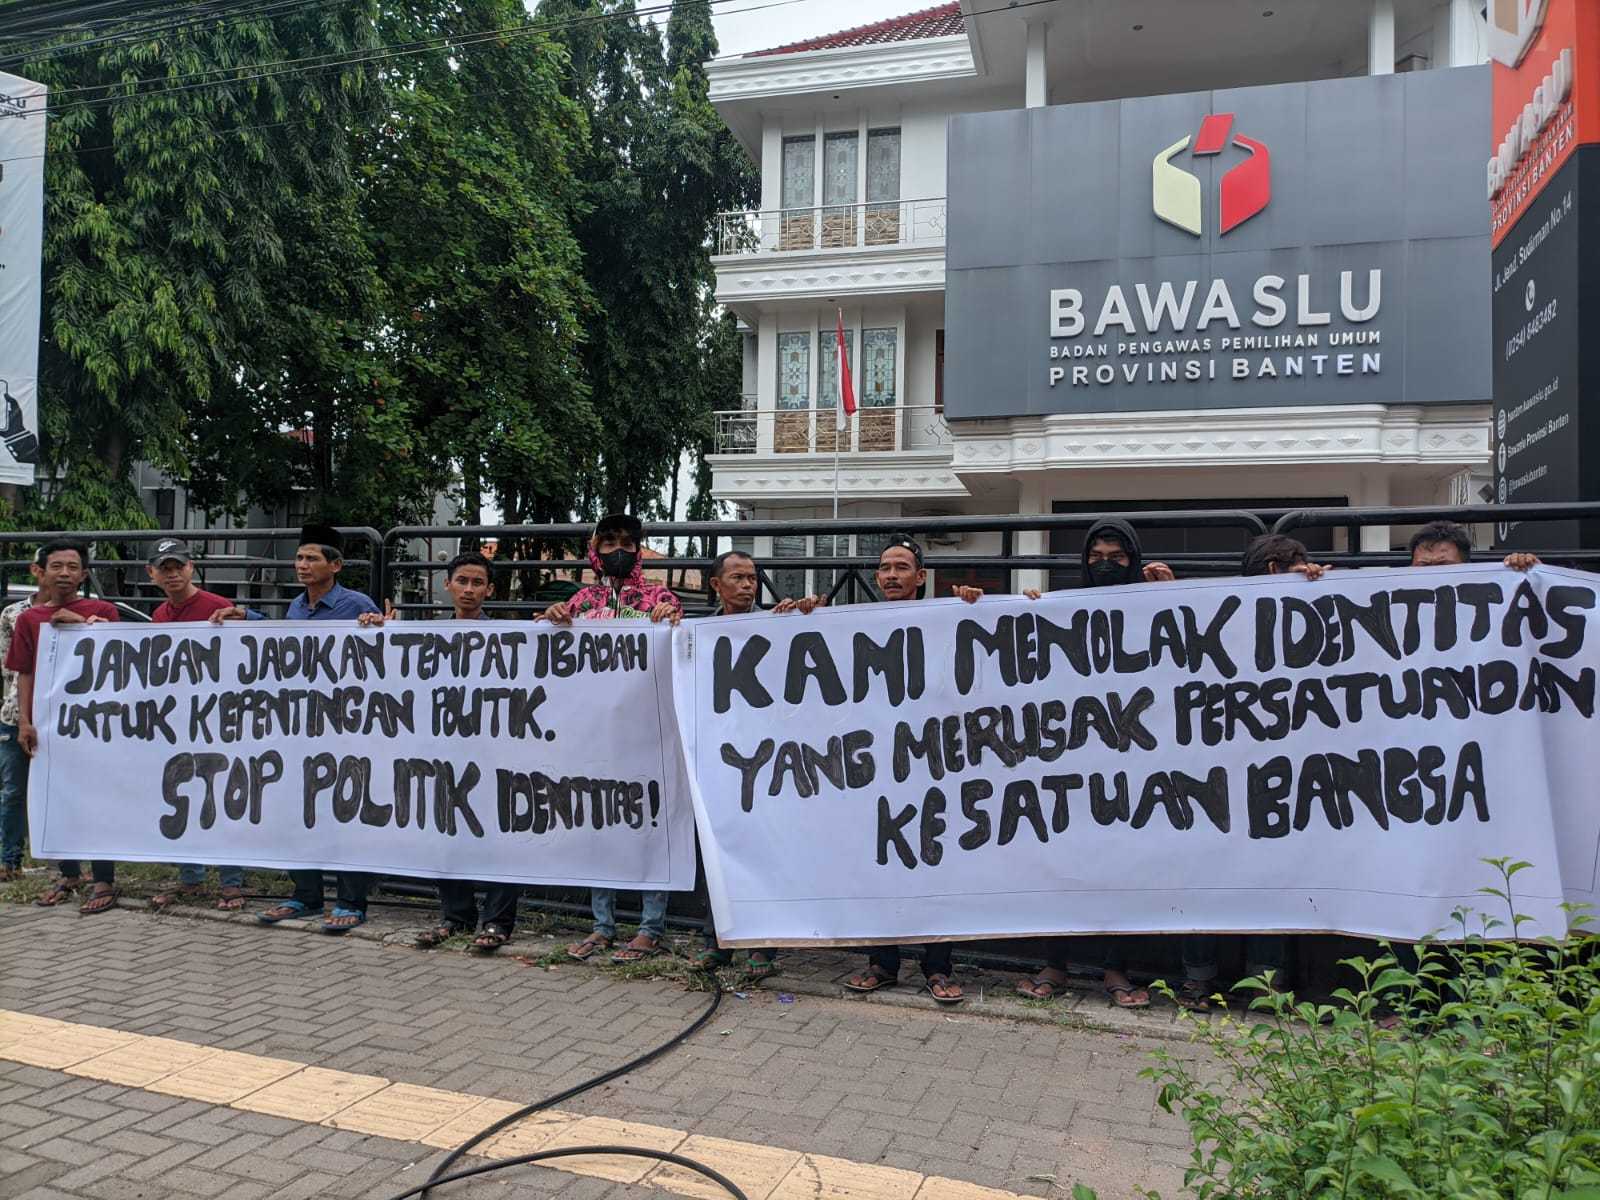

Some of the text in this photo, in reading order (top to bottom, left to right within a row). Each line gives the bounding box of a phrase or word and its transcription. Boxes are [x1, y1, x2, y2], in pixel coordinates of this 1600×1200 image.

[1531, 126, 1573, 186] BANTEN
[1518, 221, 1550, 265] Sudirman
[1050, 269, 1382, 339] BAWASLU
[1050, 330, 1381, 359] BADAN PENGAWAS PEMILIHAN UMUM
[1050, 352, 1381, 387] PROVINSI BANTEN
[64, 634, 221, 694] JANGAN
[237, 632, 385, 684] JADIKAN
[390, 631, 527, 680] TEMPAT
[534, 631, 647, 678] IBADAH
[713, 582, 1597, 714] KAMI MENOLAK IDENTITAS
[57, 695, 177, 744] UNTUK
[189, 686, 415, 743] KEPENTINGAN
[720, 729, 876, 813] YANG
[893, 686, 1158, 780] MERUSAK
[159, 750, 284, 840] STOP
[303, 752, 485, 838] POLITIK
[876, 741, 1490, 869] KESATUAN BANGSA
